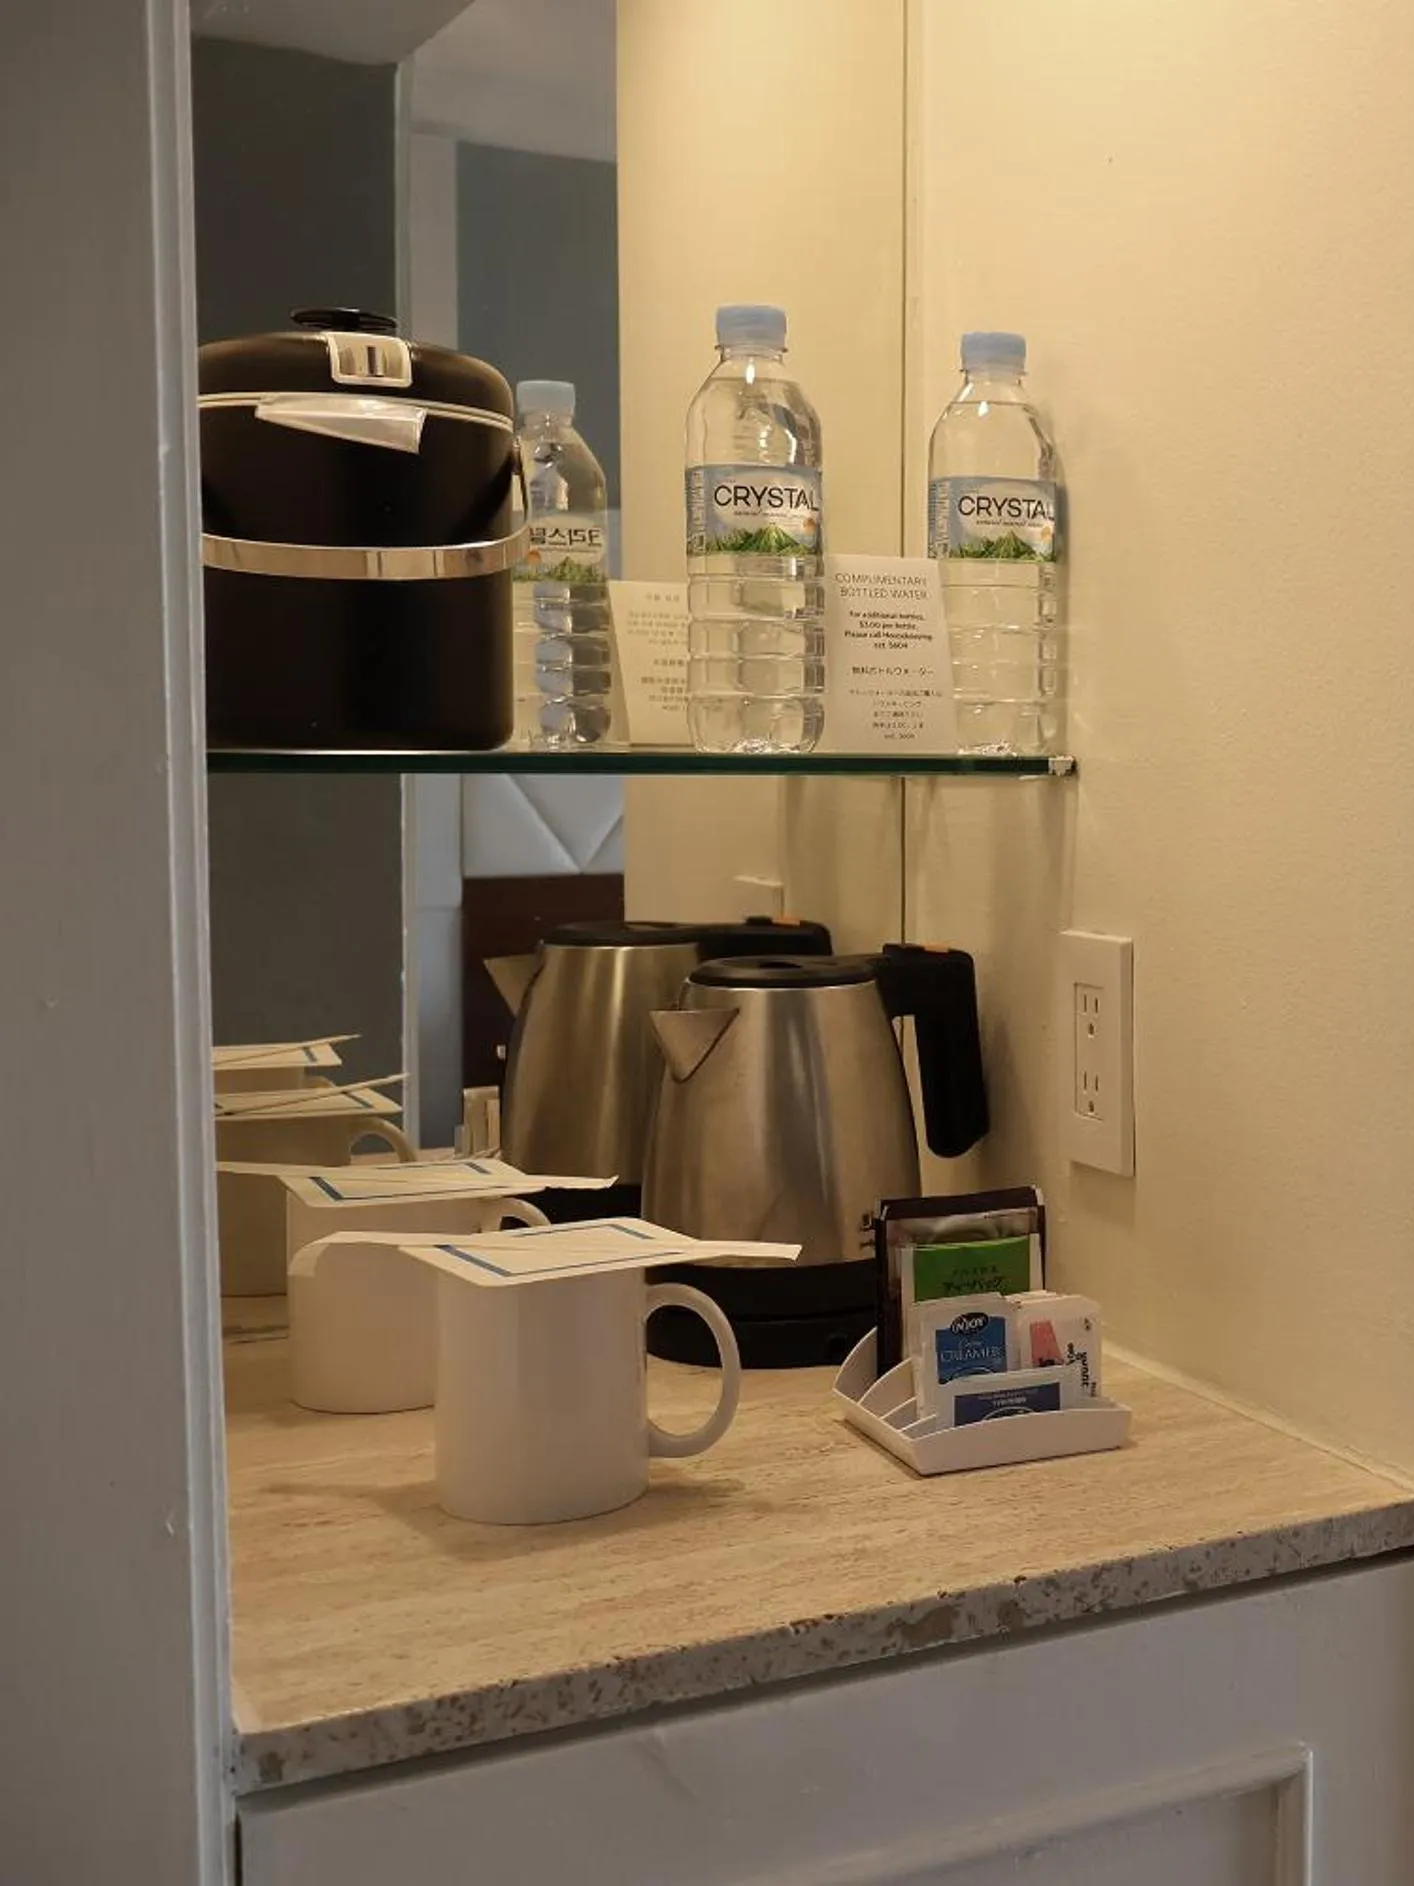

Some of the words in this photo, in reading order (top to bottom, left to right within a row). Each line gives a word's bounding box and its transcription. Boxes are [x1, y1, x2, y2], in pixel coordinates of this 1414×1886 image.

[714, 484, 820, 512] CRYSTAL
[835, 572, 928, 586] COMPLIMENTARY
[840, 587, 888, 599] BOTTLED
[890, 589, 928, 601] WATER
